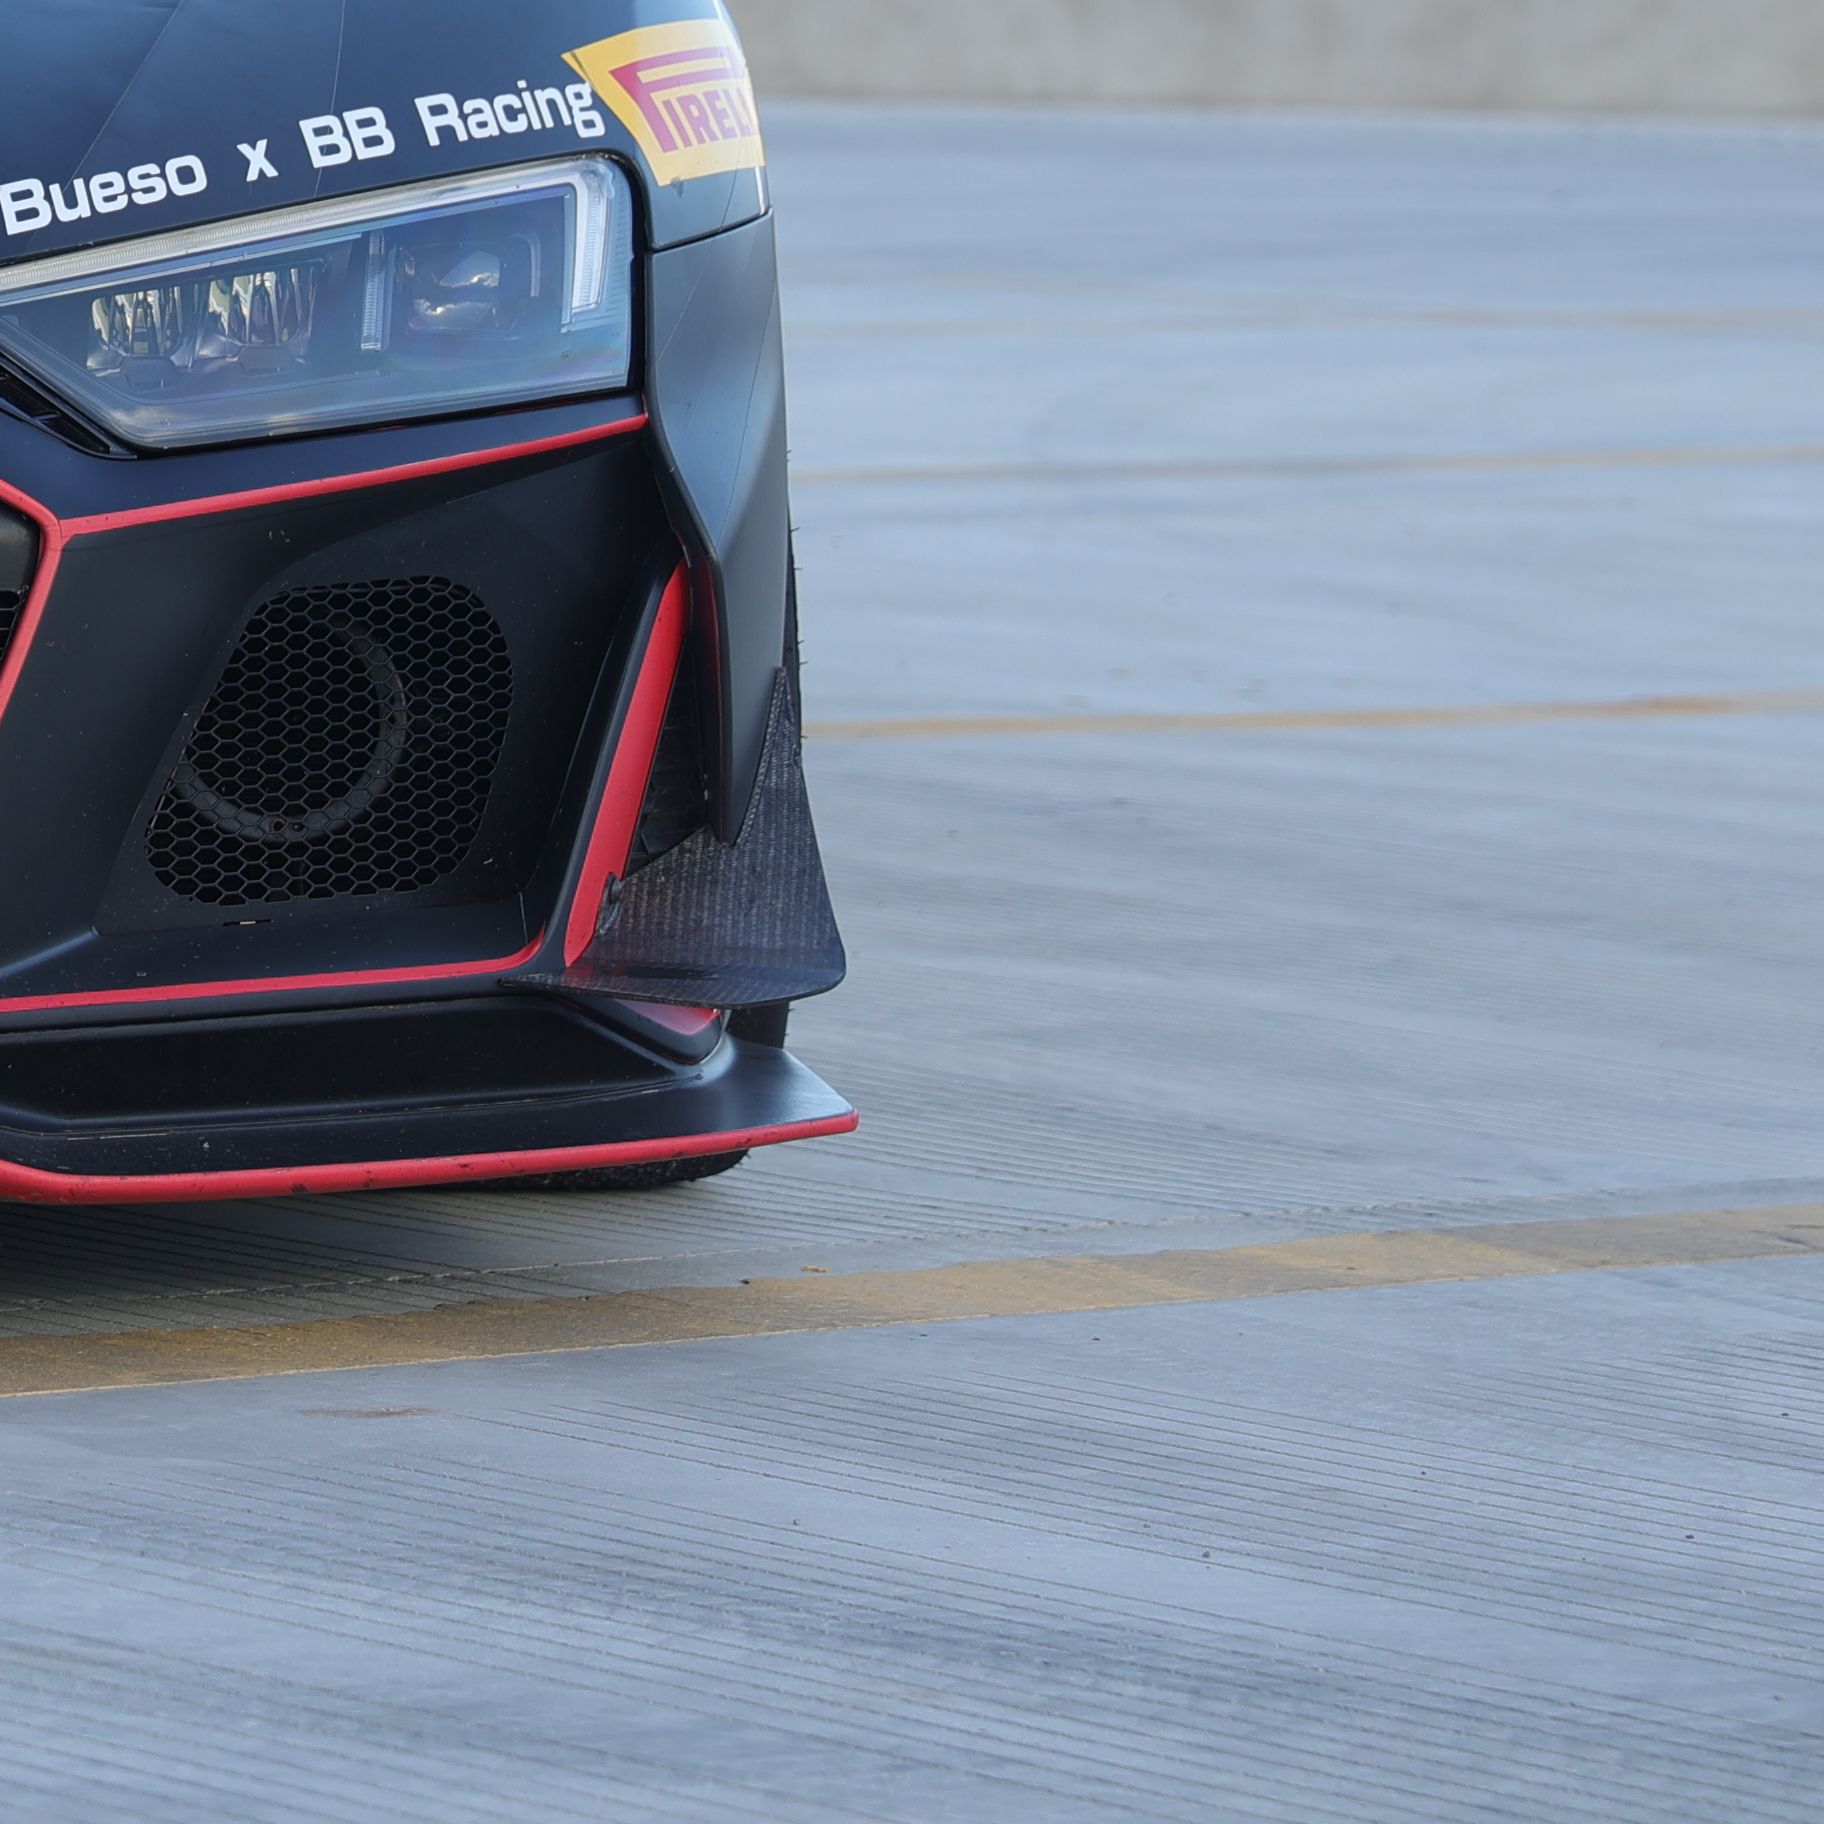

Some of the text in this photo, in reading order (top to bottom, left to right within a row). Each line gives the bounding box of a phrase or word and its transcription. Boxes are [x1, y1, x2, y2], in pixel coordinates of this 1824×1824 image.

[236, 139, 279, 182] x
[299, 106, 396, 168] BB
[414, 80, 606, 147] Racing
